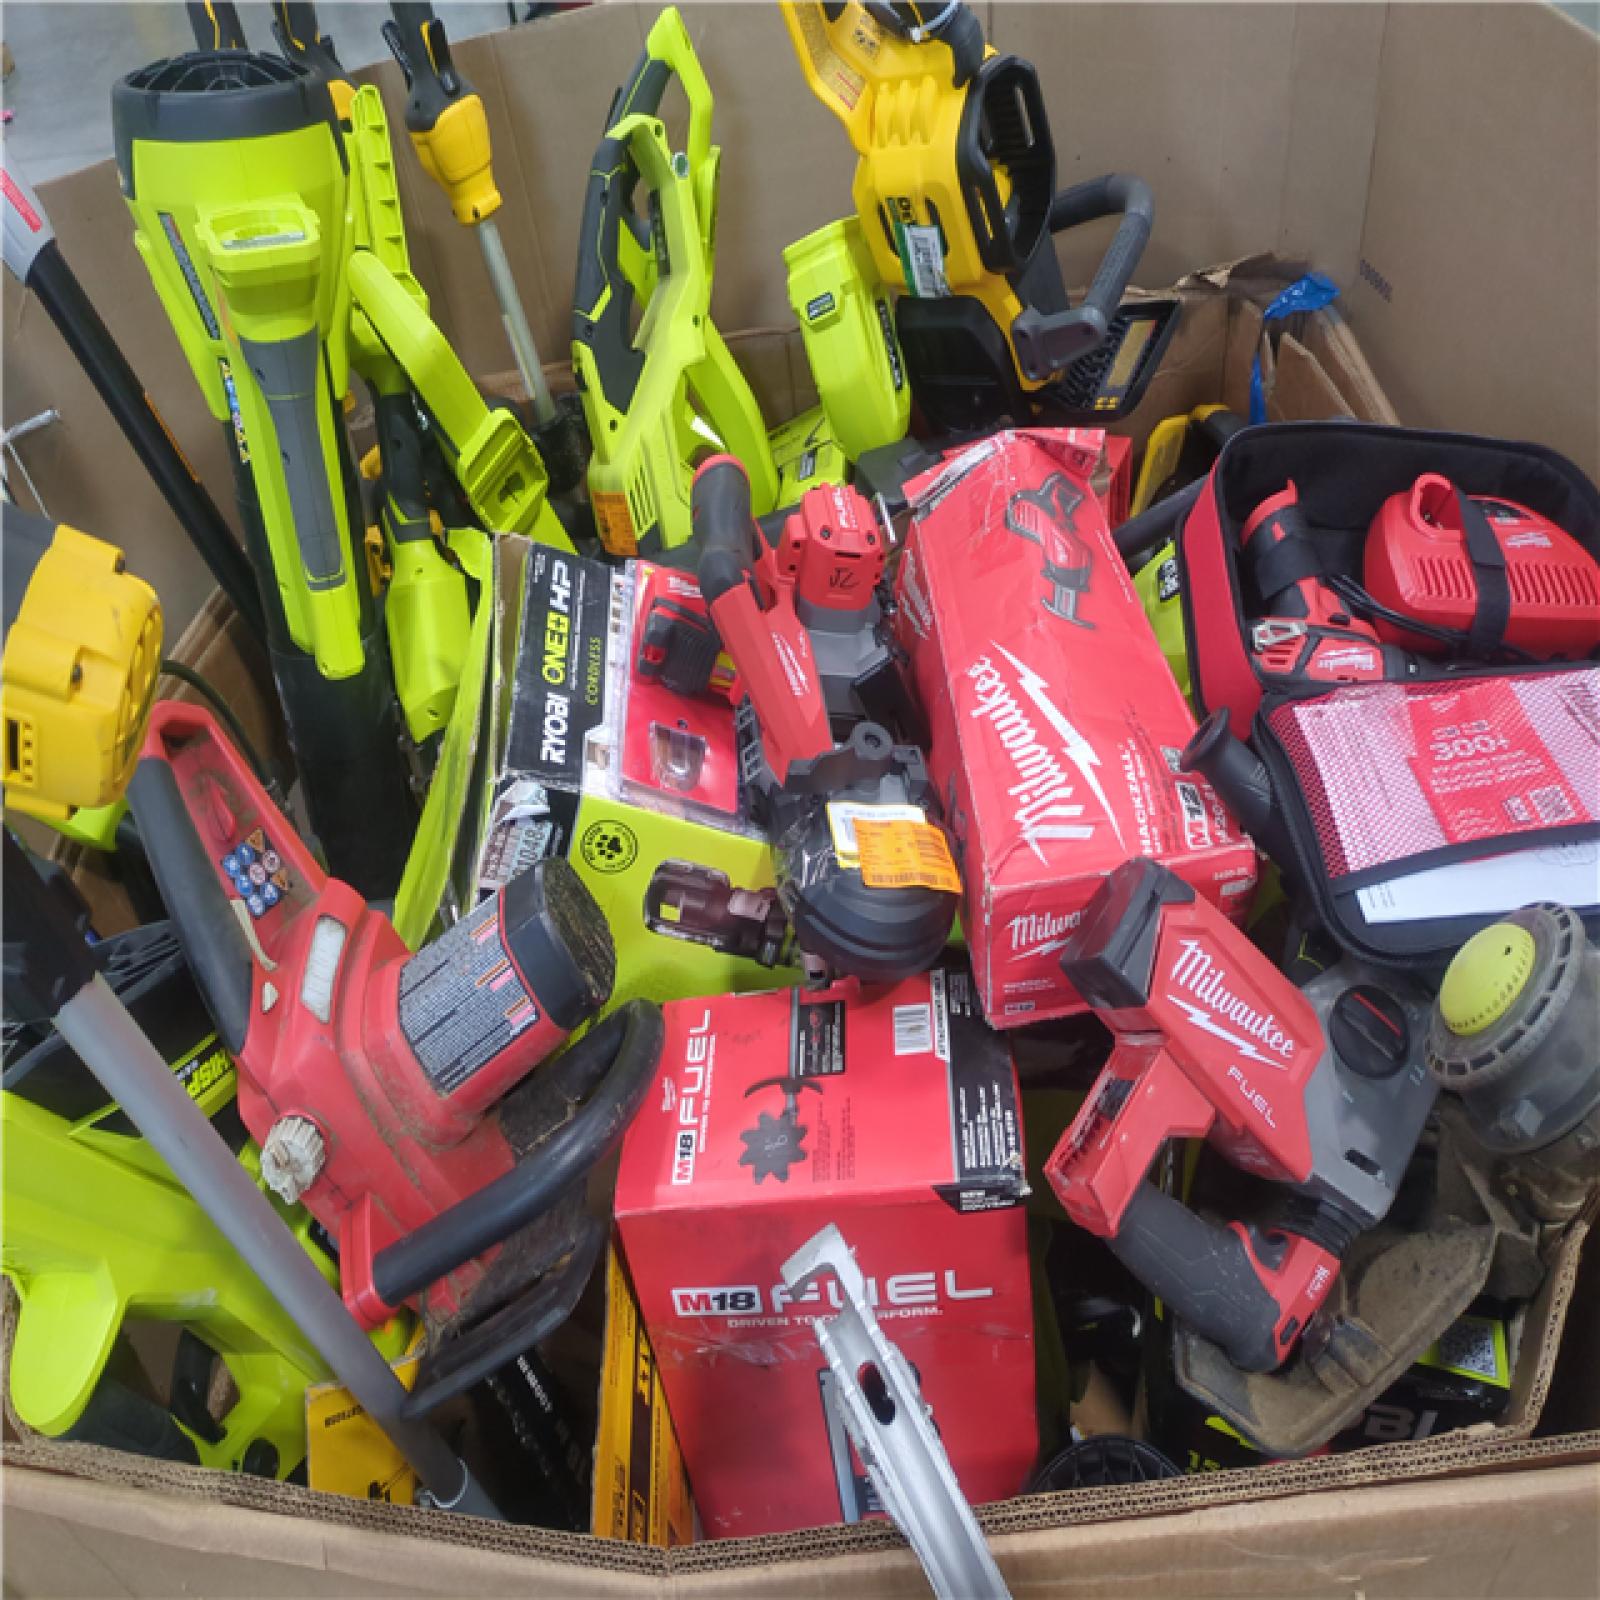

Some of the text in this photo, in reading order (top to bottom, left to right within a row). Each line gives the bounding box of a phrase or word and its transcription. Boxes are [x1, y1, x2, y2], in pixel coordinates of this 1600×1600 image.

[550, 559, 571, 613] HP
[585, 636, 603, 706] CORDLESS
[540, 692, 571, 765] RYOBI
[967, 655, 1095, 866] Milwaukee
[1177, 782, 1212, 848] M12
[1008, 910, 1081, 950] Milwa
[1170, 938, 1294, 1058] Milwaukee
[675, 1009, 711, 1183] M18 FUEL
[1227, 1065, 1276, 1129] FUEL
[675, 1269, 993, 1313] M18 FUEL
[727, 1316, 788, 1328] DRIVEN
